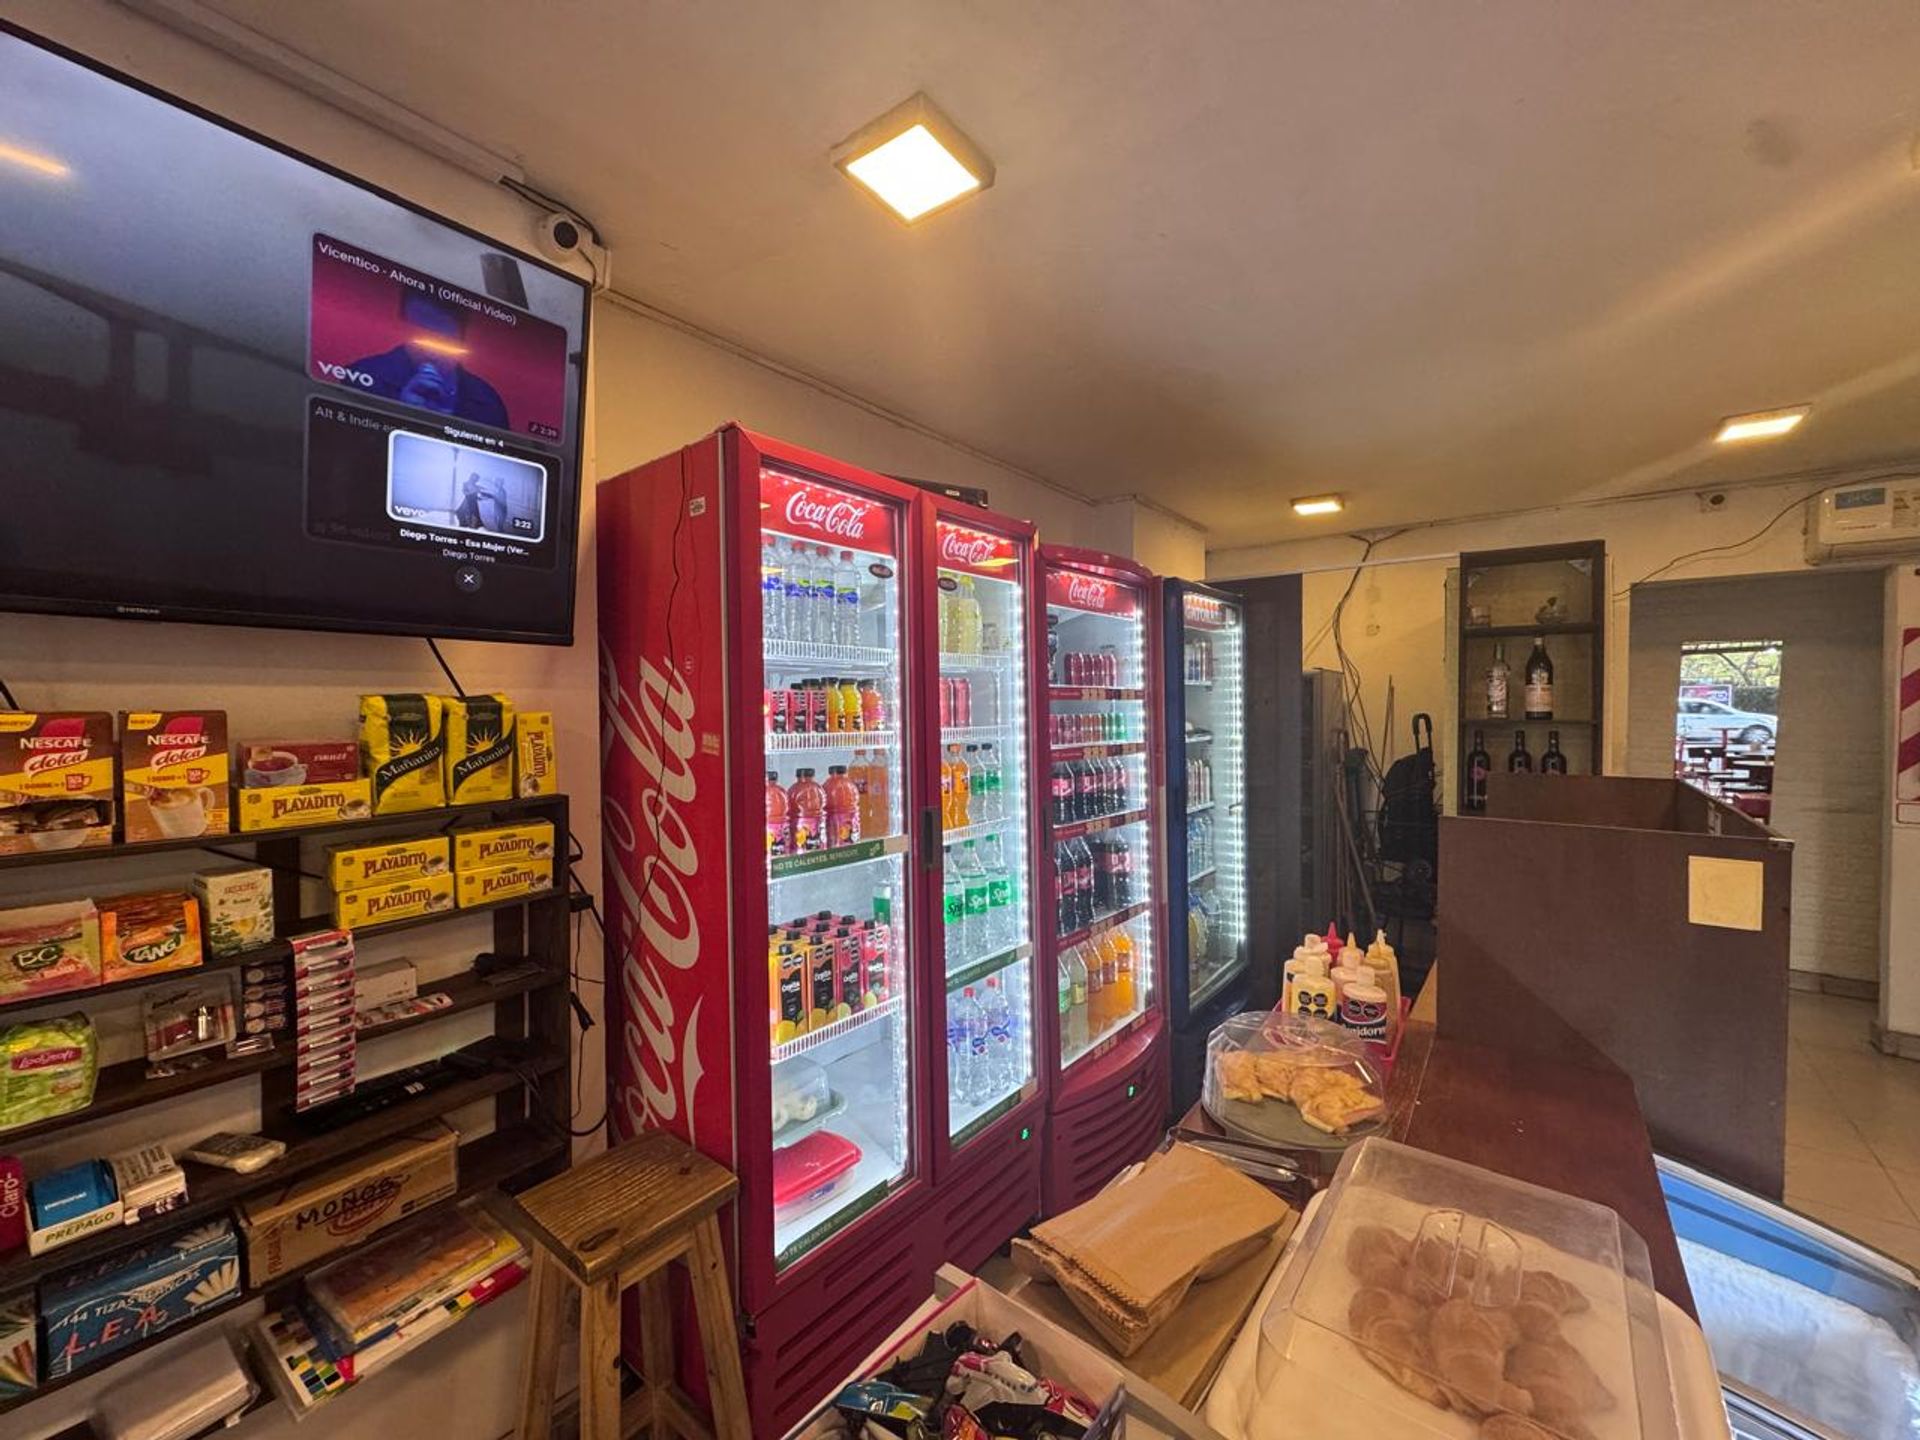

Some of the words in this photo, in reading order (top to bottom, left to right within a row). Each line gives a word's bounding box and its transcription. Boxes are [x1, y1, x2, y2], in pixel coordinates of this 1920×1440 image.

[317, 242, 380, 274] Vicentico
[389, 269, 426, 291] Ahora
[438, 287, 481, 311] (Official
[483, 303, 517, 326] Video)
[317, 360, 374, 388] vevo
[315, 406, 333, 420] Alt
[336, 411, 346, 421] &
[350, 414, 380, 430] Indie
[443, 425, 483, 442] Siguiente
[400, 528, 427, 542] Diego
[428, 532, 458, 546] Torres
[465, 540, 482, 550] Esa
[442, 549, 467, 561] Diego
[469, 553, 495, 565] Torres
[380, 745, 440, 781] Mañanita
[457, 742, 510, 776] Mañanita
[527, 731, 545, 777] PLAYADITO
[272, 793, 345, 820] PLAYADITO
[479, 838, 533, 860] PLAYADITO
[363, 853, 427, 879] PLAYADITO
[481, 870, 534, 895] PLAYADITO
[367, 888, 431, 916] PLAYADITO
[17, 947, 58, 966] BC
[130, 939, 177, 961] TANG
[44, 1212, 115, 1243] PREPAGO
[95, 1299, 134, 1317] TIZAS
